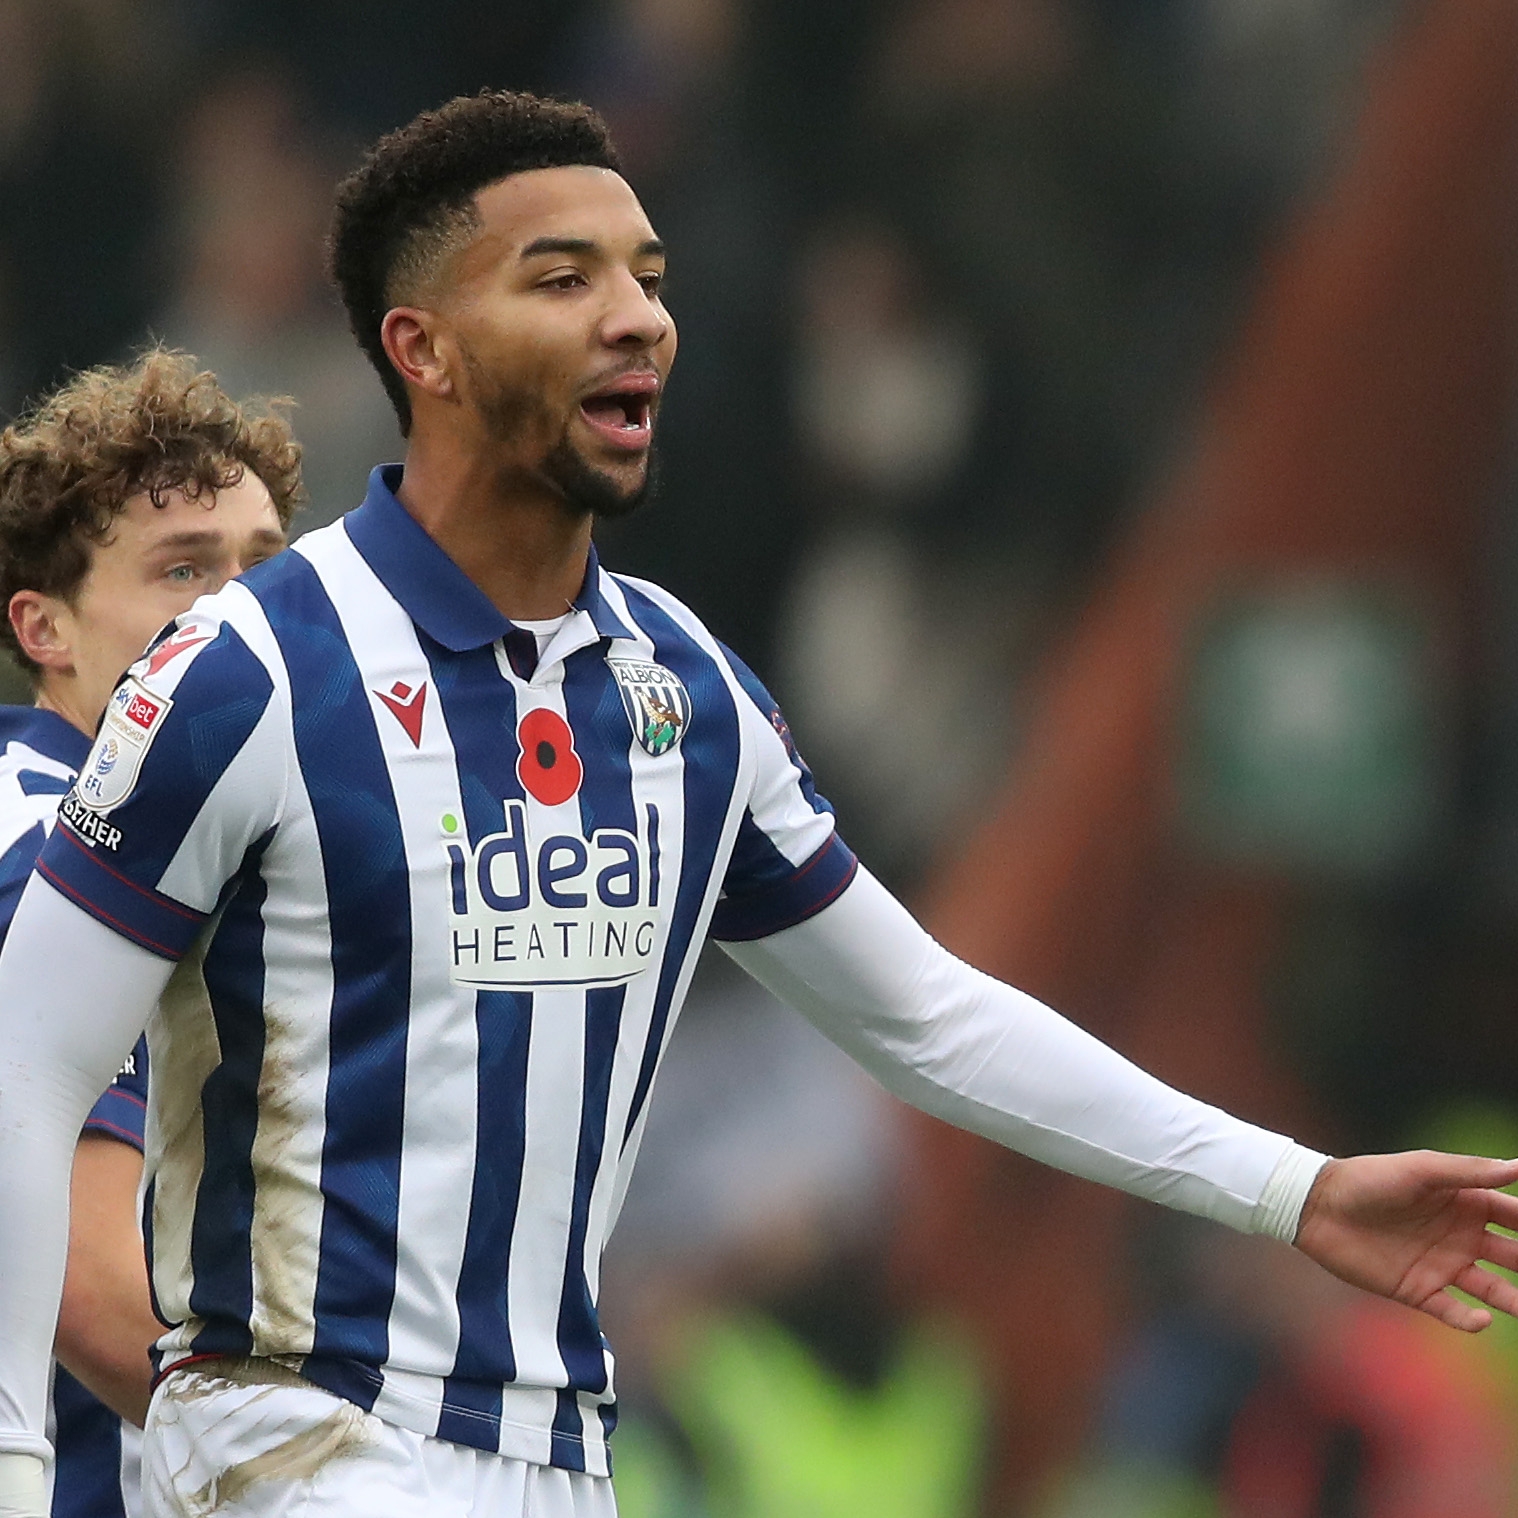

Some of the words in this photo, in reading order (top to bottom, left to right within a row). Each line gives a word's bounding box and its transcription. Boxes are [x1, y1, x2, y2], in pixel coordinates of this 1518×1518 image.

[619, 667, 677, 685] ALBION
[130, 695, 154, 723] bet
[84, 774, 104, 797] EFL
[441, 802, 660, 915] ideal
[453, 921, 654, 966] HEATING
